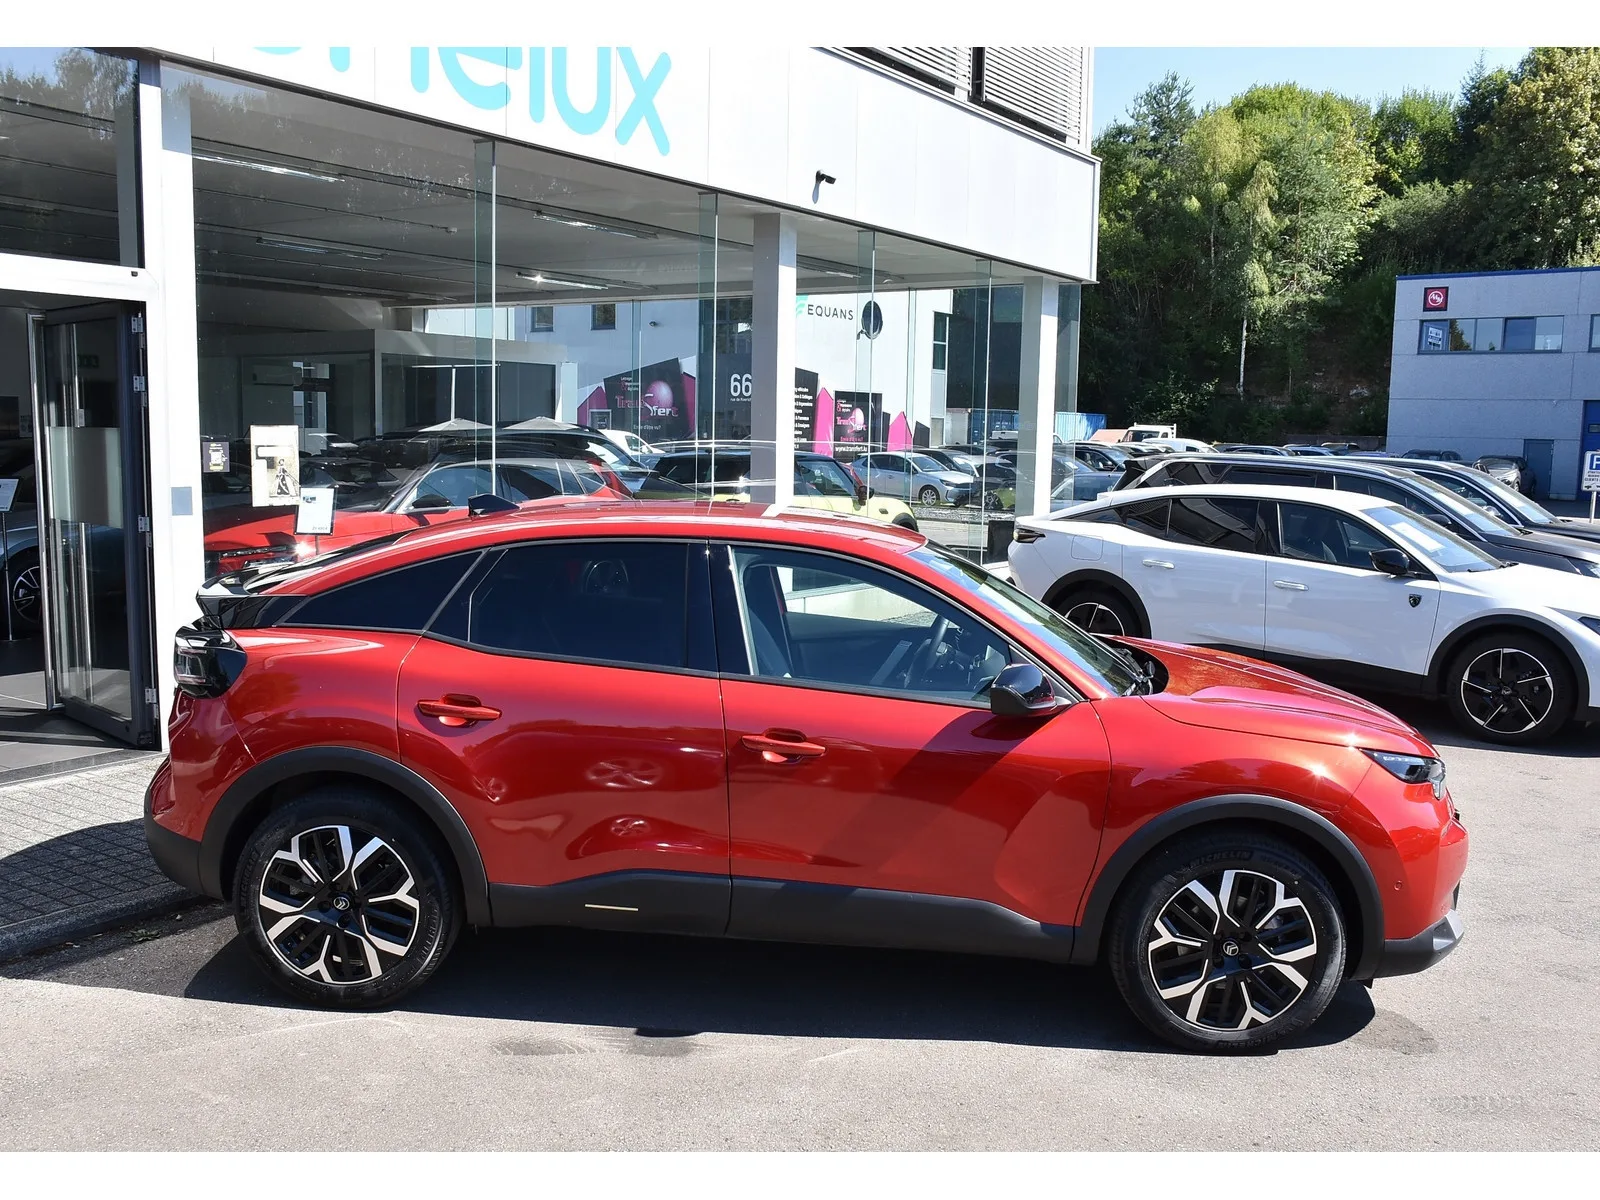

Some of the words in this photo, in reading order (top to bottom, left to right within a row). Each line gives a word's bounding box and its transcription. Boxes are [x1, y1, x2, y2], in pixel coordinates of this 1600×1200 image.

[807, 304, 854, 321] EQUANS
[730, 373, 752, 397] 66
[1189, 849, 1252, 867] MICHELIN
